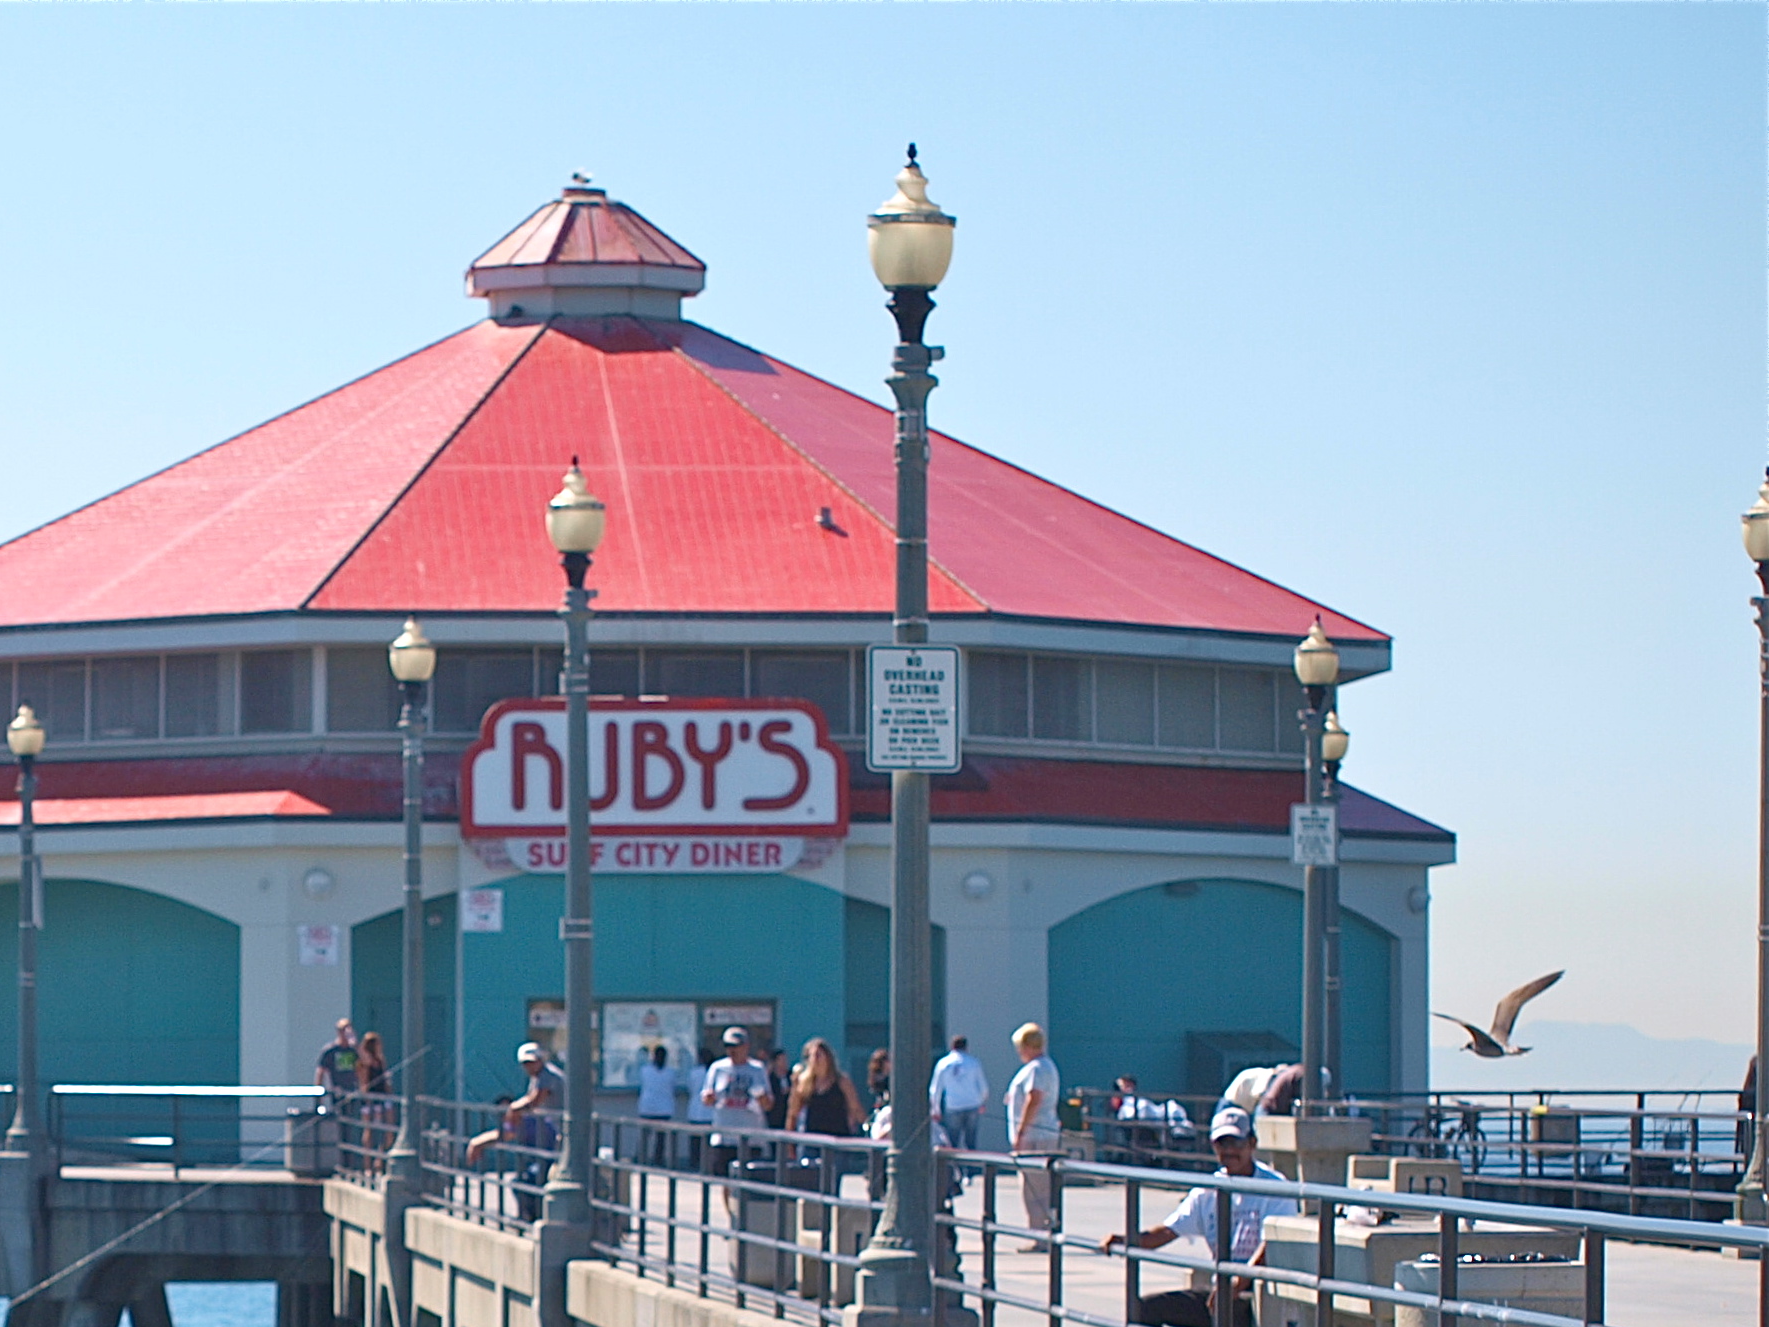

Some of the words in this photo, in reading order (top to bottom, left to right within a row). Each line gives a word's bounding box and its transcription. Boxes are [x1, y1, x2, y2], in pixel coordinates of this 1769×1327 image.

[906, 656, 922, 667] NO
[884, 670, 945, 681] OVERHEAD
[890, 684, 939, 695] CASTING
[528, 842, 604, 867] SUF
[615, 842, 680, 867] CITY
[690, 842, 782, 867] DINER
